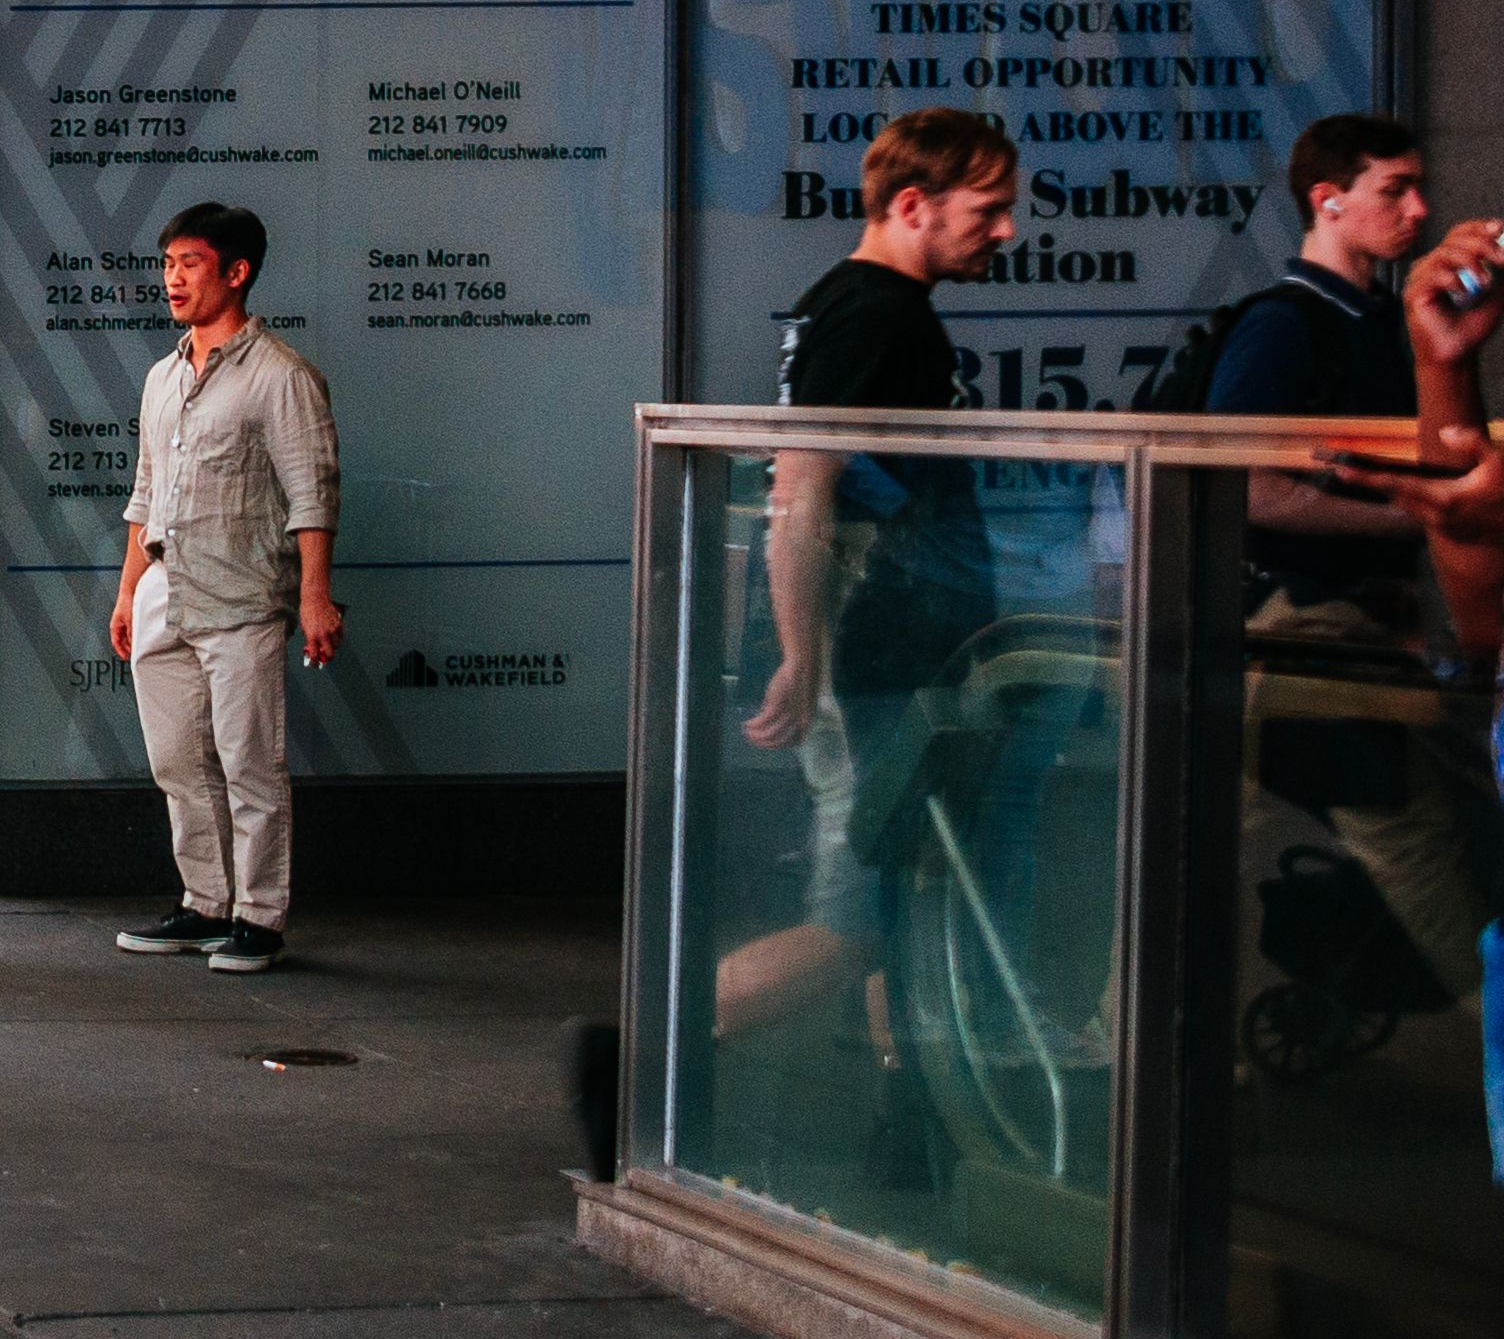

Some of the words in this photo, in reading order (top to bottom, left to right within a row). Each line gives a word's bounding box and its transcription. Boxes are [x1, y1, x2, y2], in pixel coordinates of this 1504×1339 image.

[870, 2, 1007, 36] TIMES
[1018, 1, 1193, 41] SQUARE
[791, 56, 951, 90] RETAIL
[963, 55, 1271, 90] OPPORTUNITY
[50, 85, 112, 105] Jason
[118, 85, 237, 104] Greenstone
[368, 81, 446, 101] Michael
[453, 80, 521, 101] O'Neill
[50, 119, 87, 138] 212
[94, 118, 130, 138] 841
[139, 117, 186, 137] 7713
[368, 116, 405, 134] 212
[412, 115, 448, 134] 841
[456, 114, 508, 134] 7909
[1019, 110, 1163, 142] ABOVE
[1175, 109, 1263, 141] THE
[48, 145, 319, 169] jason.greenstone@cushwake.com
[368, 143, 608, 163] michael.oneill@cushwake.com
[1029, 166, 1268, 233] Subway
[46, 252, 93, 271] Alan
[368, 249, 421, 268] Sean
[426, 249, 490, 268] Moran
[46, 285, 84, 304] 212
[90, 285, 127, 303] 841
[367, 282, 408, 302] 212
[411, 282, 449, 302] 841
[454, 281, 507, 301] 7668
[367, 309, 592, 329] sean.moran@cushwake.com
[48, 418, 120, 438] Steven
[48, 452, 85, 471] 212
[93, 452, 128, 471] 713
[445, 654, 548, 670] CUSHMAN
[444, 670, 567, 687] WAKEFIELD
